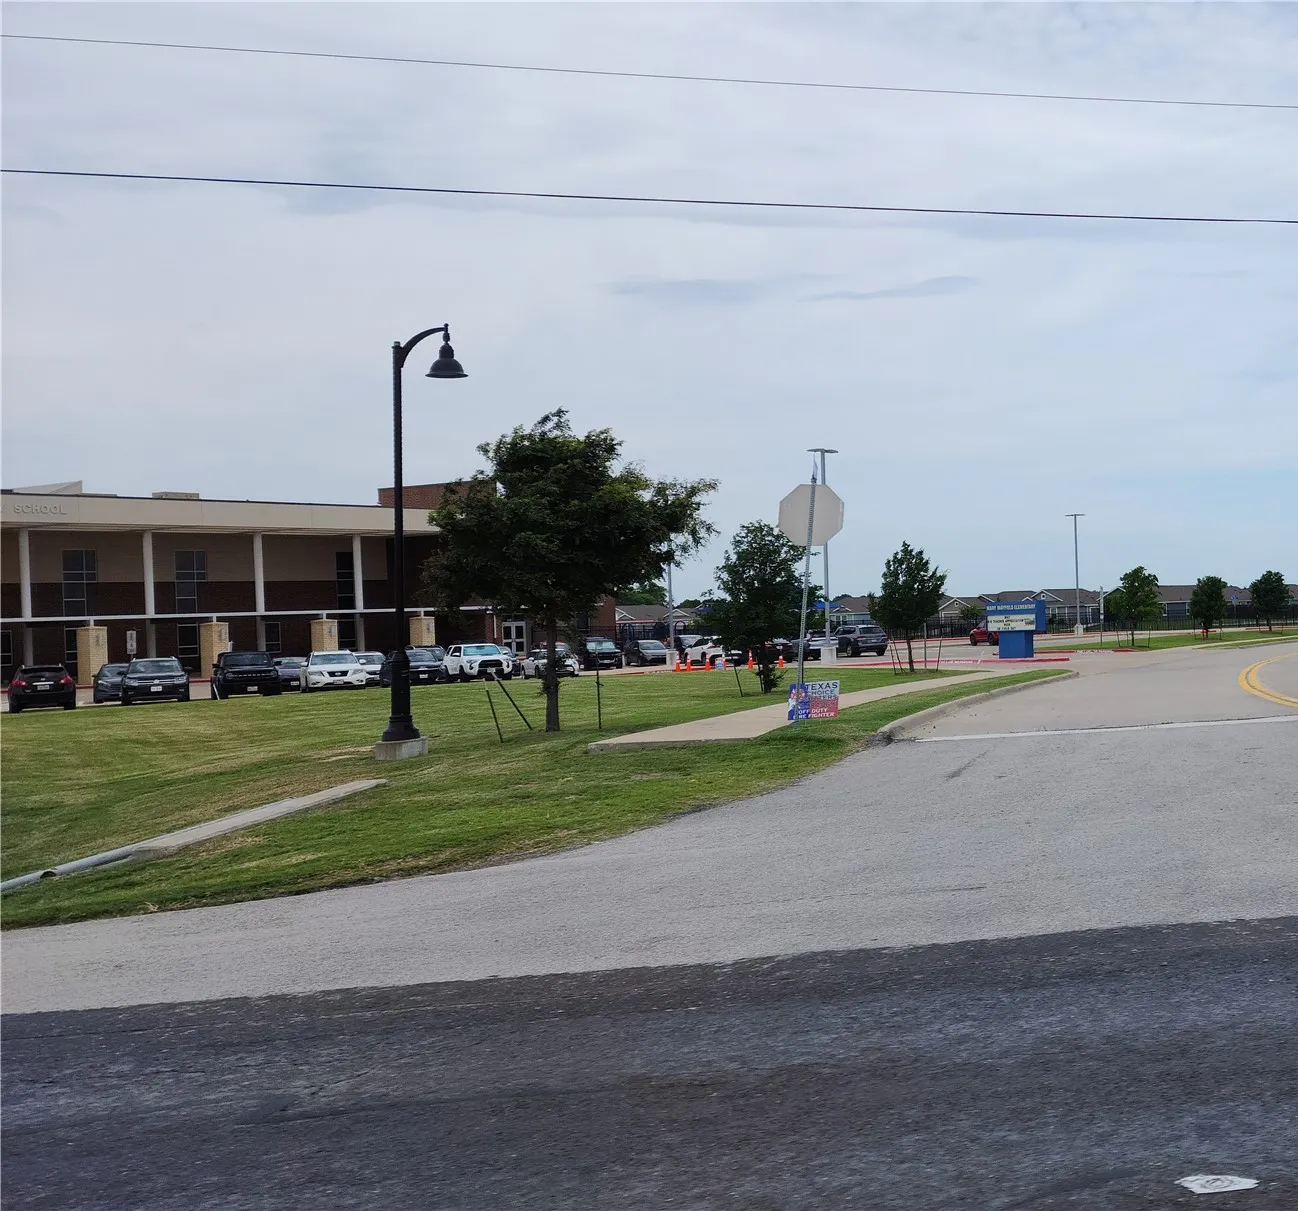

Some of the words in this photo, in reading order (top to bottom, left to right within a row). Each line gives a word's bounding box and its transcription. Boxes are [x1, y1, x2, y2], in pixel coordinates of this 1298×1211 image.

[13, 503, 68, 516] SCHOOL
[805, 681, 838, 690] TEXAS
[808, 711, 835, 719] FIGHTER
